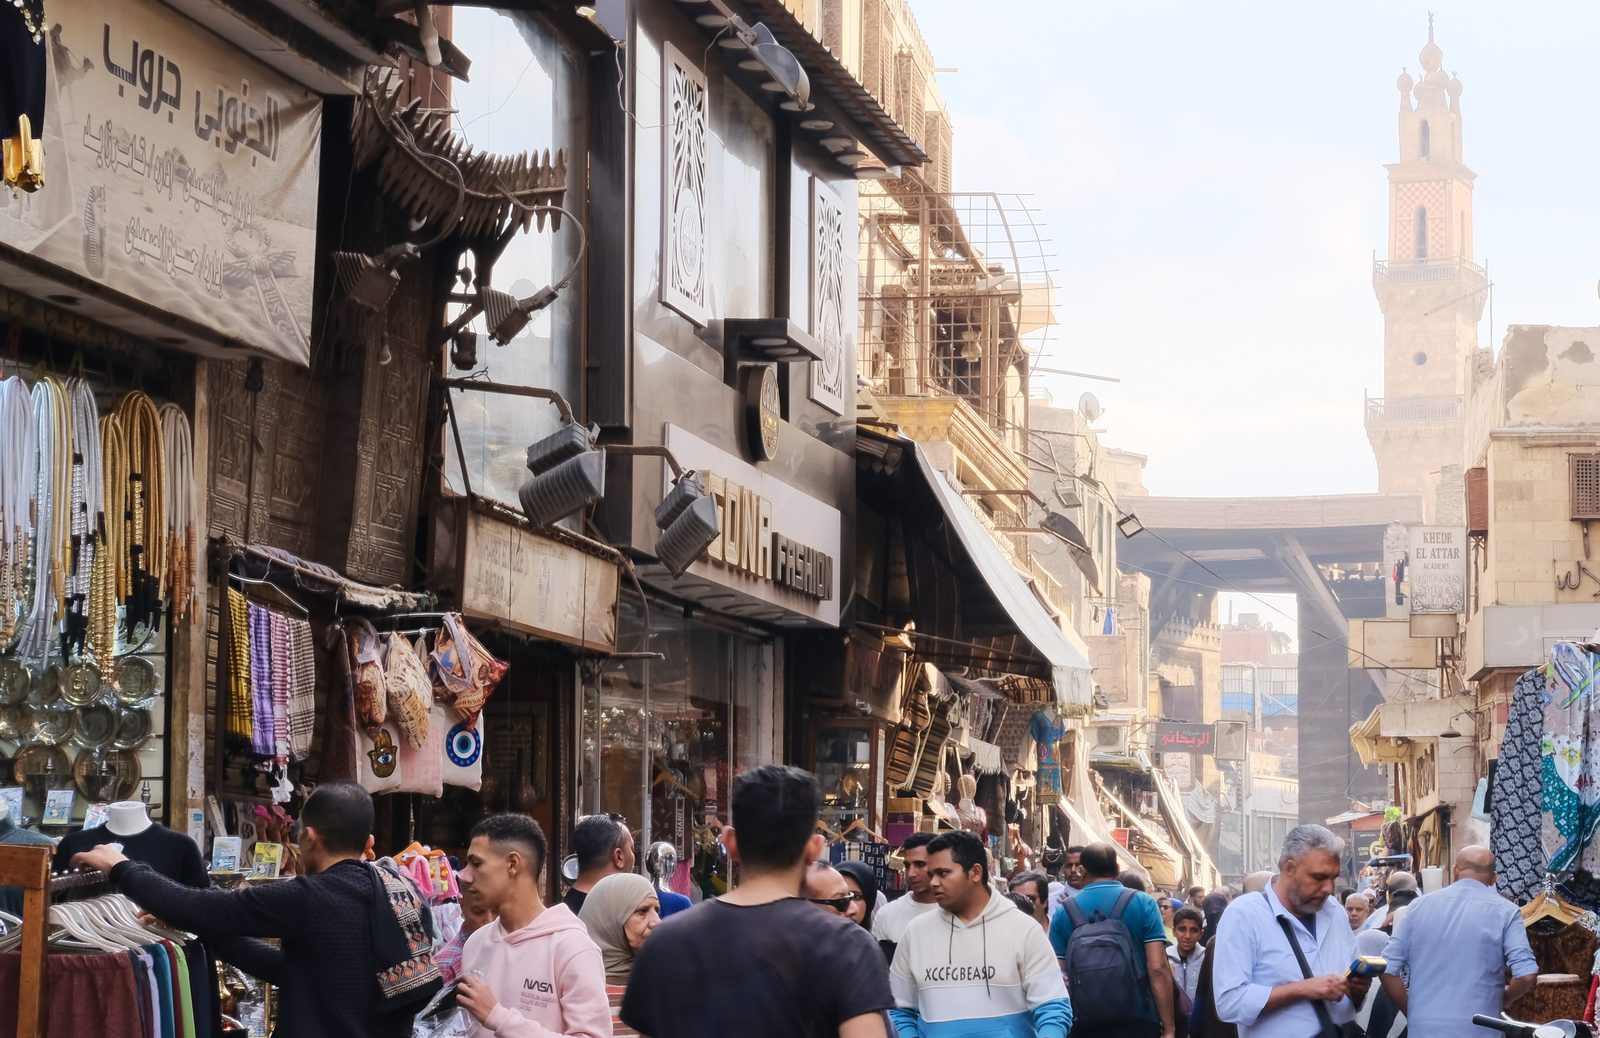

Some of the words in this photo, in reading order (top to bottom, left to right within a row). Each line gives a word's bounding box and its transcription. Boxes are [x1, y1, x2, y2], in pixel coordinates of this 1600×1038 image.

[102, 22, 182, 124] جروب
[1423, 532, 1453, 544] KHEDR
[1416, 547, 1428, 559] EL
[1430, 547, 1460, 559] ATTAR
[772, 531, 833, 601] FASHION
[523, 978, 554, 994] NASA
